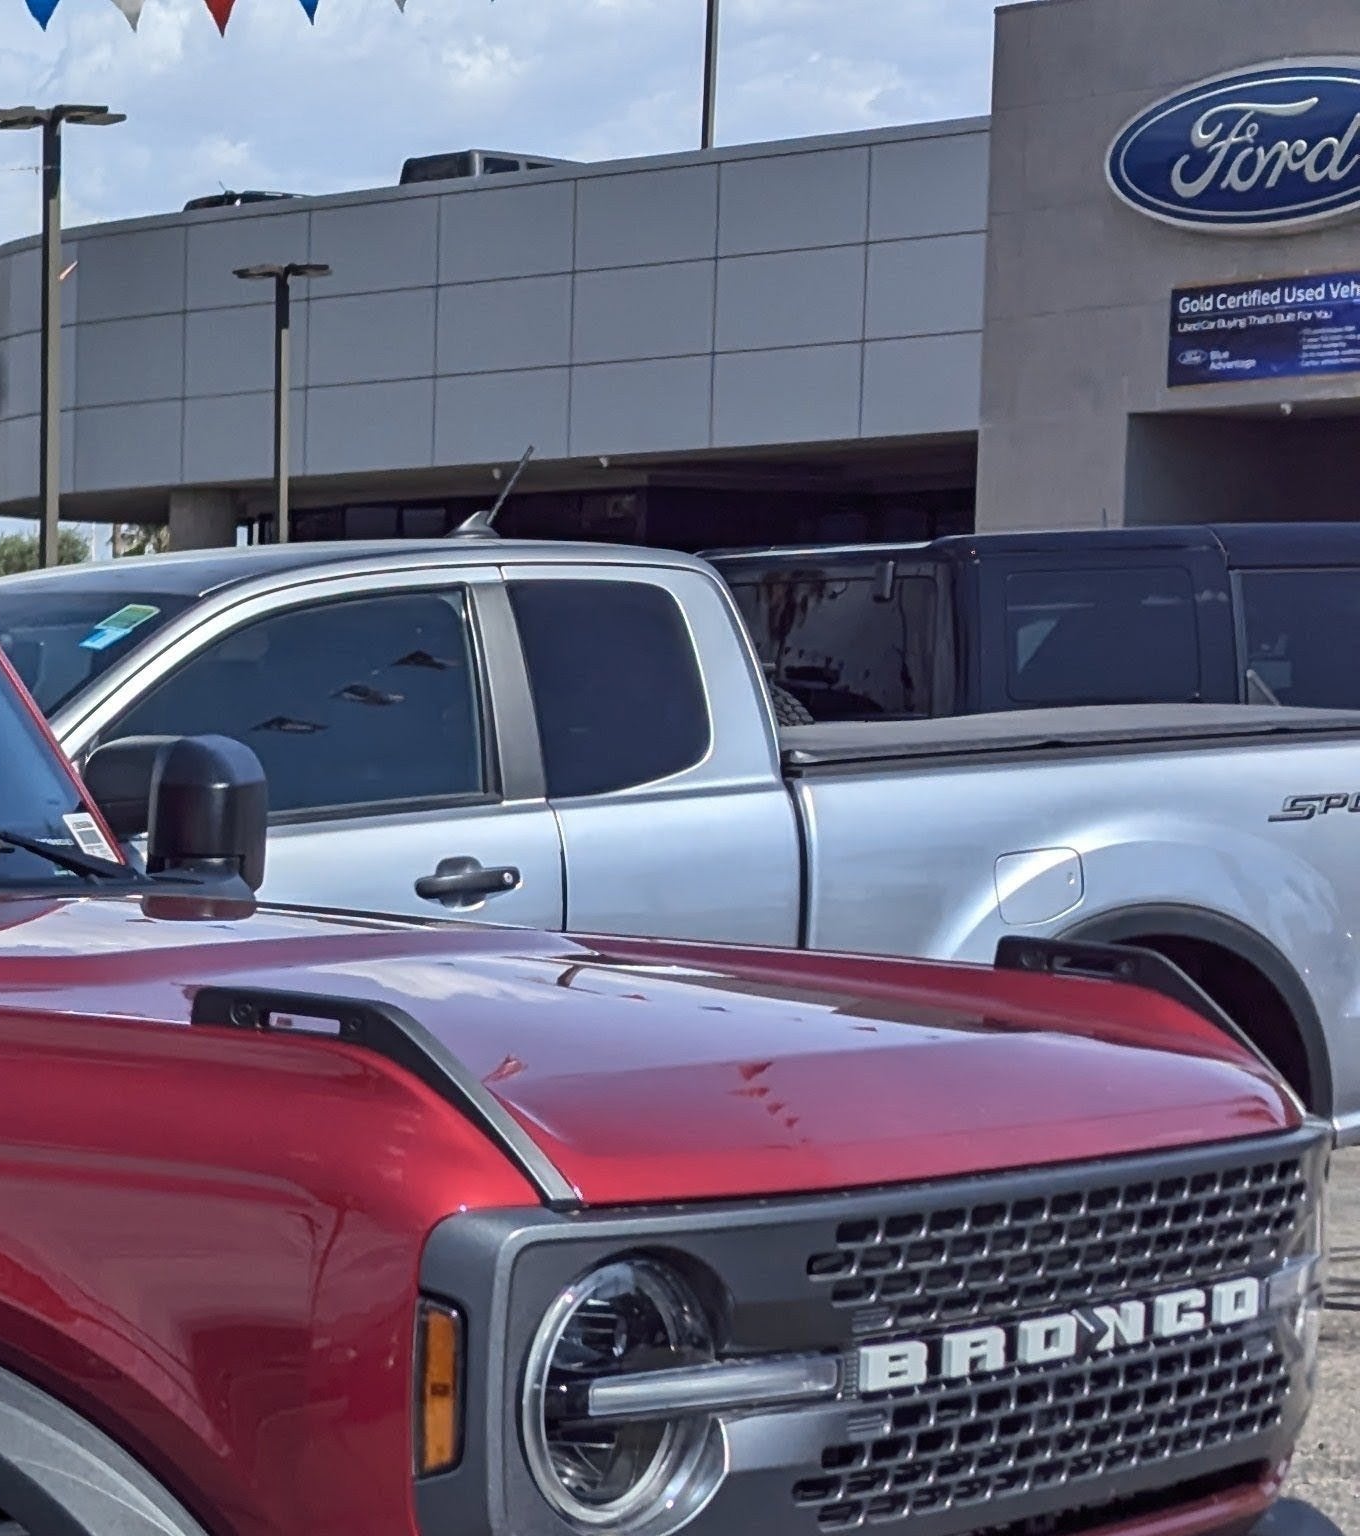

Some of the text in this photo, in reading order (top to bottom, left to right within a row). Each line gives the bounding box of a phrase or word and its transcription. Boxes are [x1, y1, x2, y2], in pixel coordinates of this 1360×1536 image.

[1170, 96, 1360, 199] Ford
[1178, 294, 1214, 314] Gold
[1216, 287, 1281, 310] Certified
[1284, 283, 1326, 304] Used
[858, 1276, 1261, 1393] BRONCO
